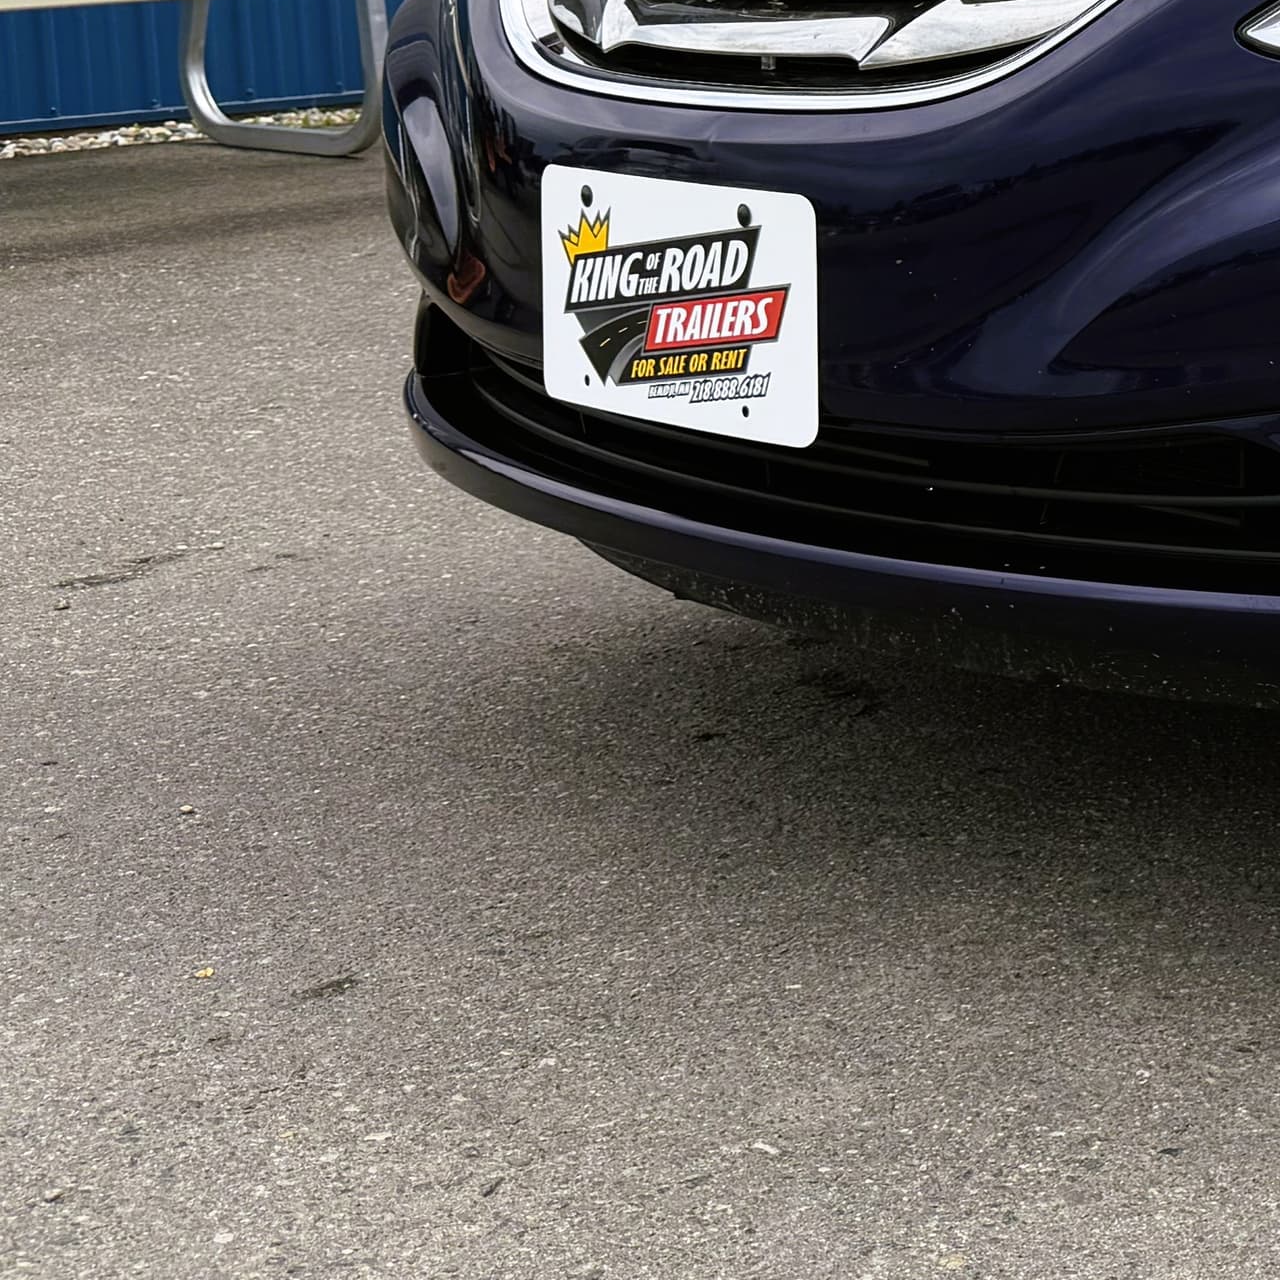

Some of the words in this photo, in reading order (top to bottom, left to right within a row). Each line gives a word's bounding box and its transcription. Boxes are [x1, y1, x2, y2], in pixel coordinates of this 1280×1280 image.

[646, 252, 662, 271] OF
[658, 239, 750, 294] ROAD
[570, 252, 643, 304] KING
[638, 277, 659, 296] THE
[654, 297, 774, 344] TRAILERS
[630, 357, 655, 379] FOR
[657, 355, 686, 376] SALE
[689, 352, 708, 373] OR
[711, 349, 748, 371] RENT
[689, 372, 772, 404] 218.888.6181
